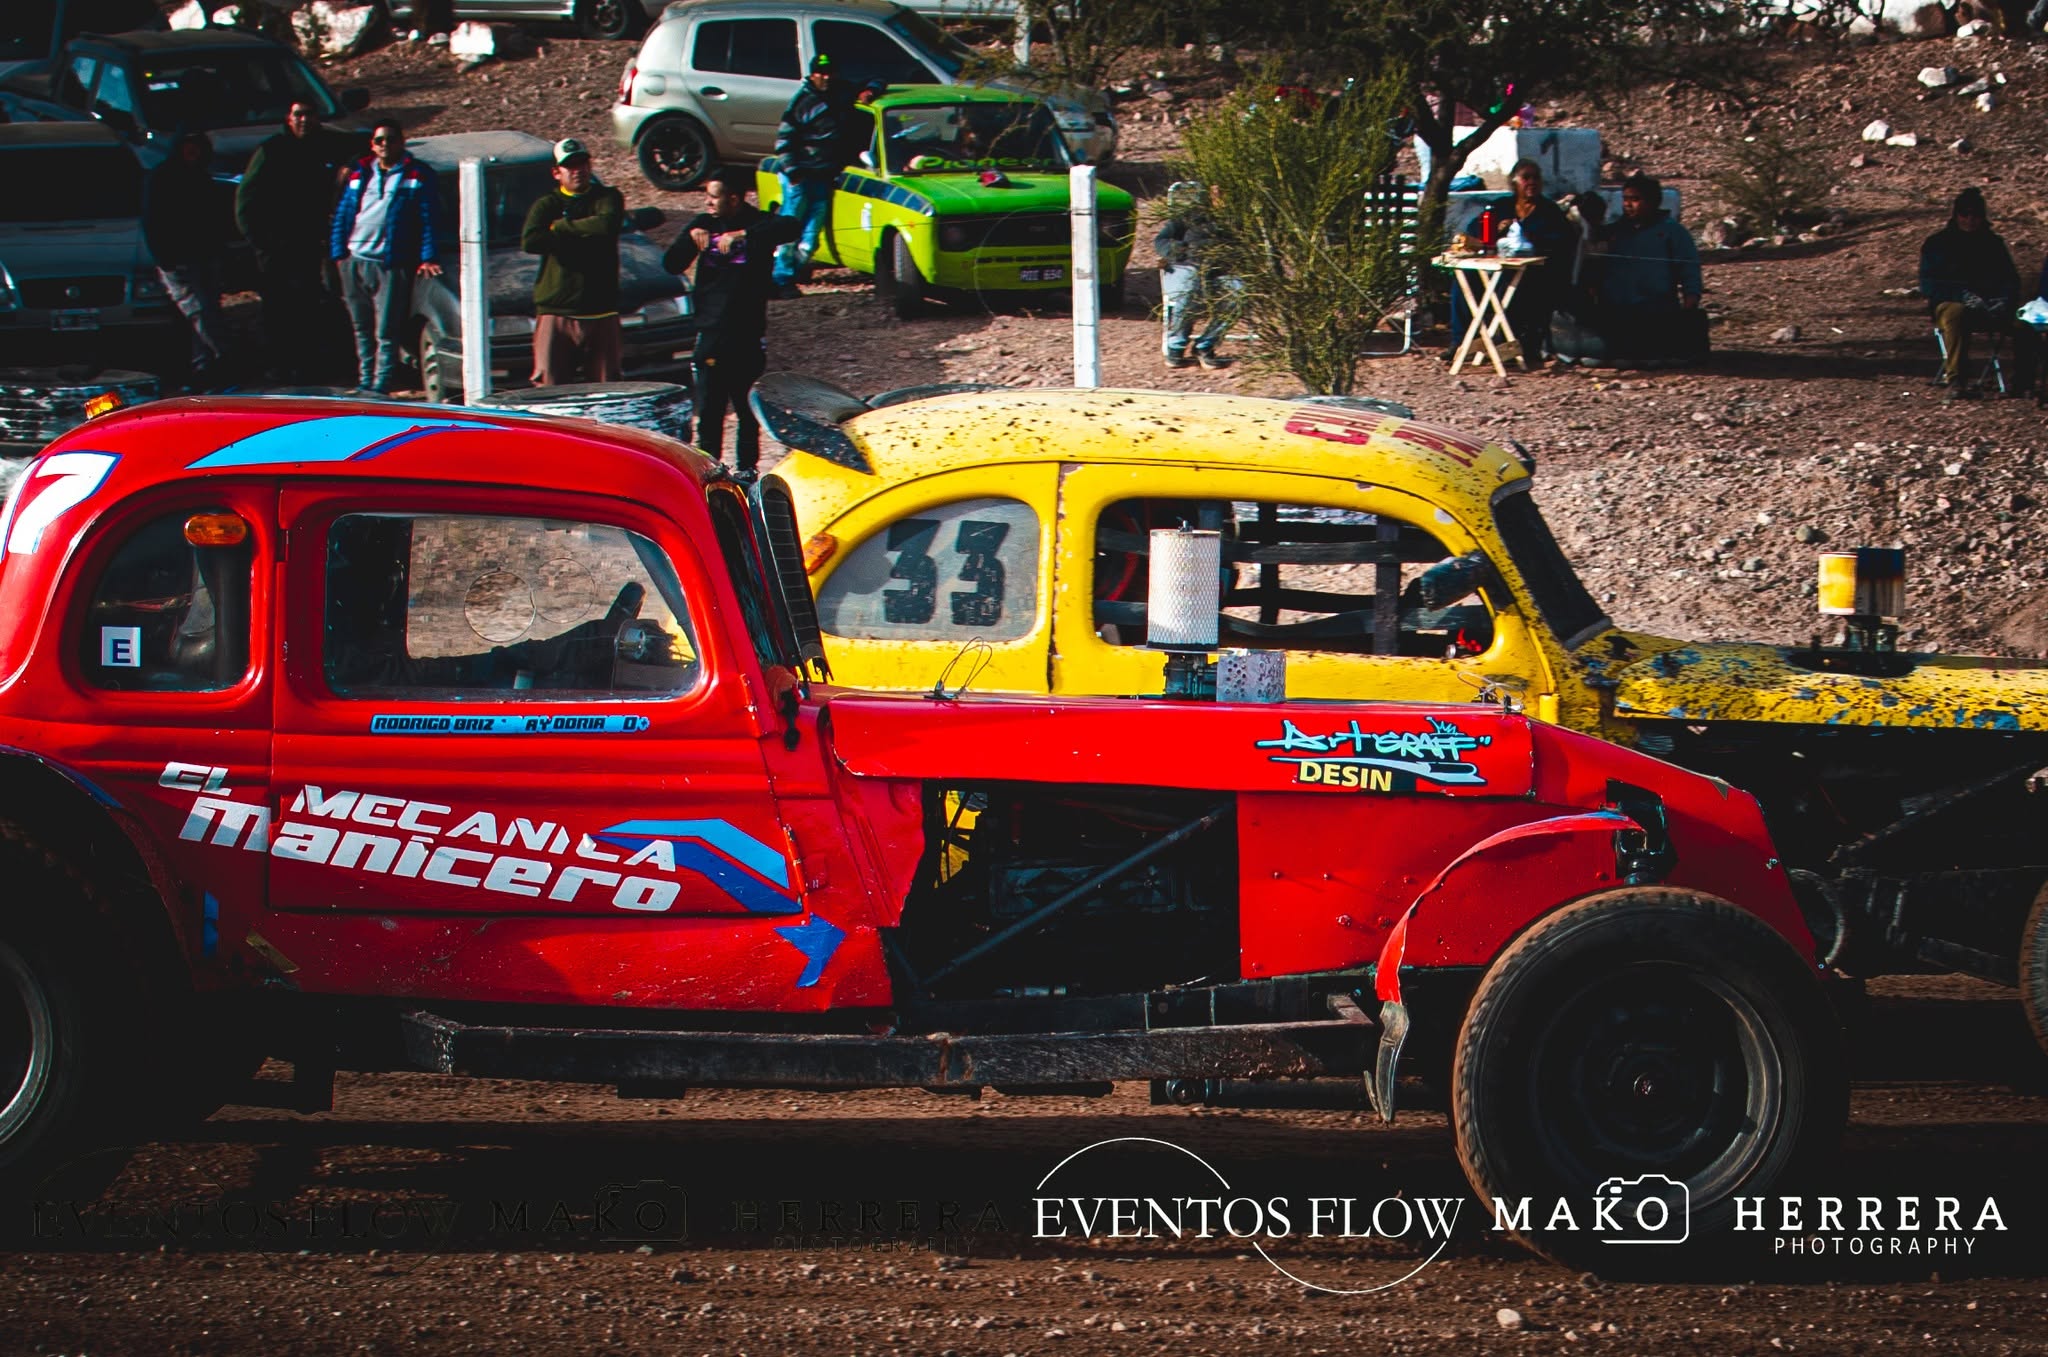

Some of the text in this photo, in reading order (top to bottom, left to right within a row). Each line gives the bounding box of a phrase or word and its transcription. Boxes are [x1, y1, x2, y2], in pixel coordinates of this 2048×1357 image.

[883, 518, 1010, 626] 33
[112, 638, 131, 664] E
[373, 716, 451, 731] RODRIGO
[158, 761, 232, 796] EL
[1299, 760, 1393, 792] DESIN
